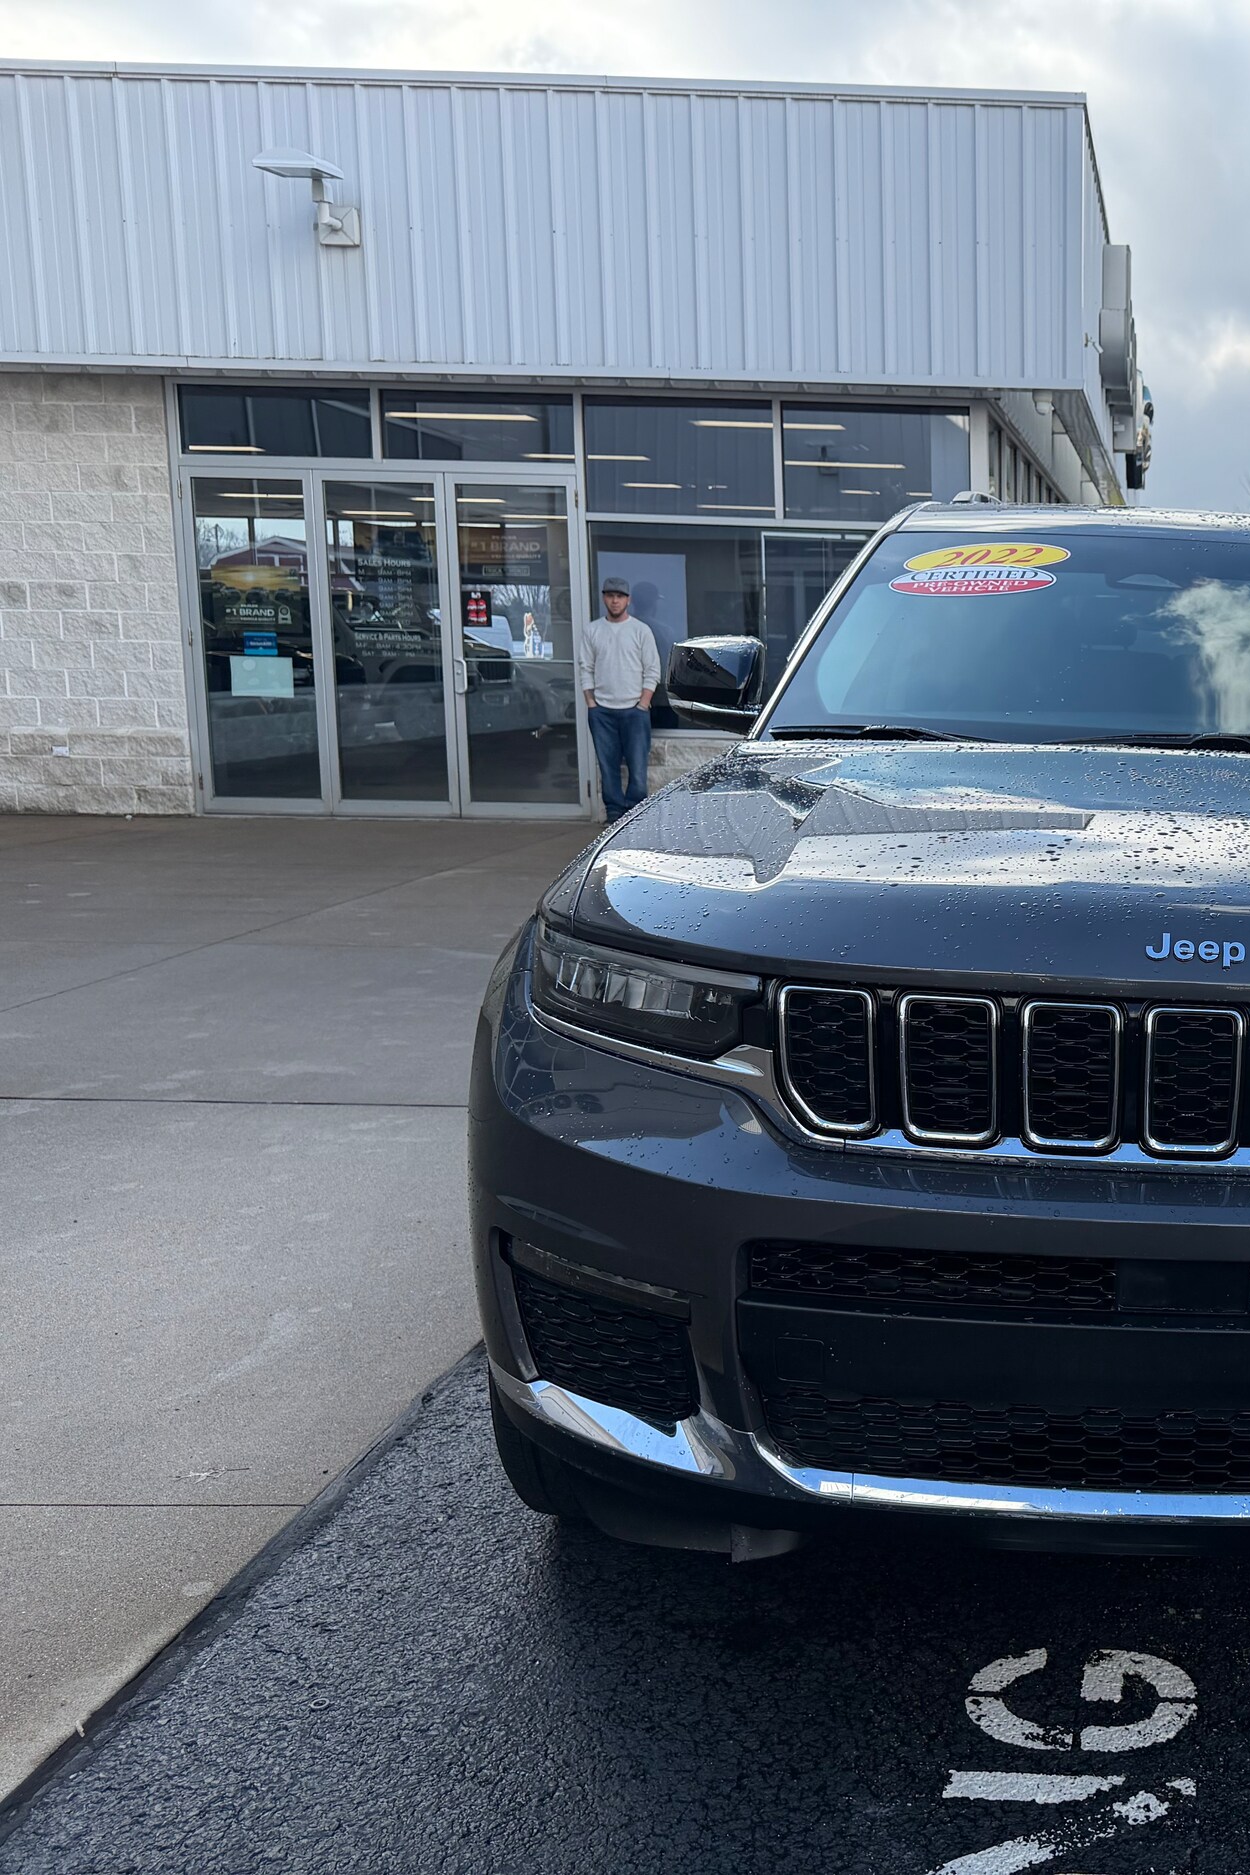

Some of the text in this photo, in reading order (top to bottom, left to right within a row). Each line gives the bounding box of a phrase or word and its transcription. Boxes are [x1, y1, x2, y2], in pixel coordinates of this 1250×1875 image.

[490, 541, 541, 552] BRAND
[936, 547, 1044, 567] 2022
[358, 558, 412, 567] SALES HOURS
[911, 569, 1038, 581] CERTIFIED
[912, 579, 1029, 588] PRE-OWNED
[929, 584, 1010, 593] VEHICLE
[239, 608, 275, 617] BRAND
[1145, 932, 1246, 970] Jeep
